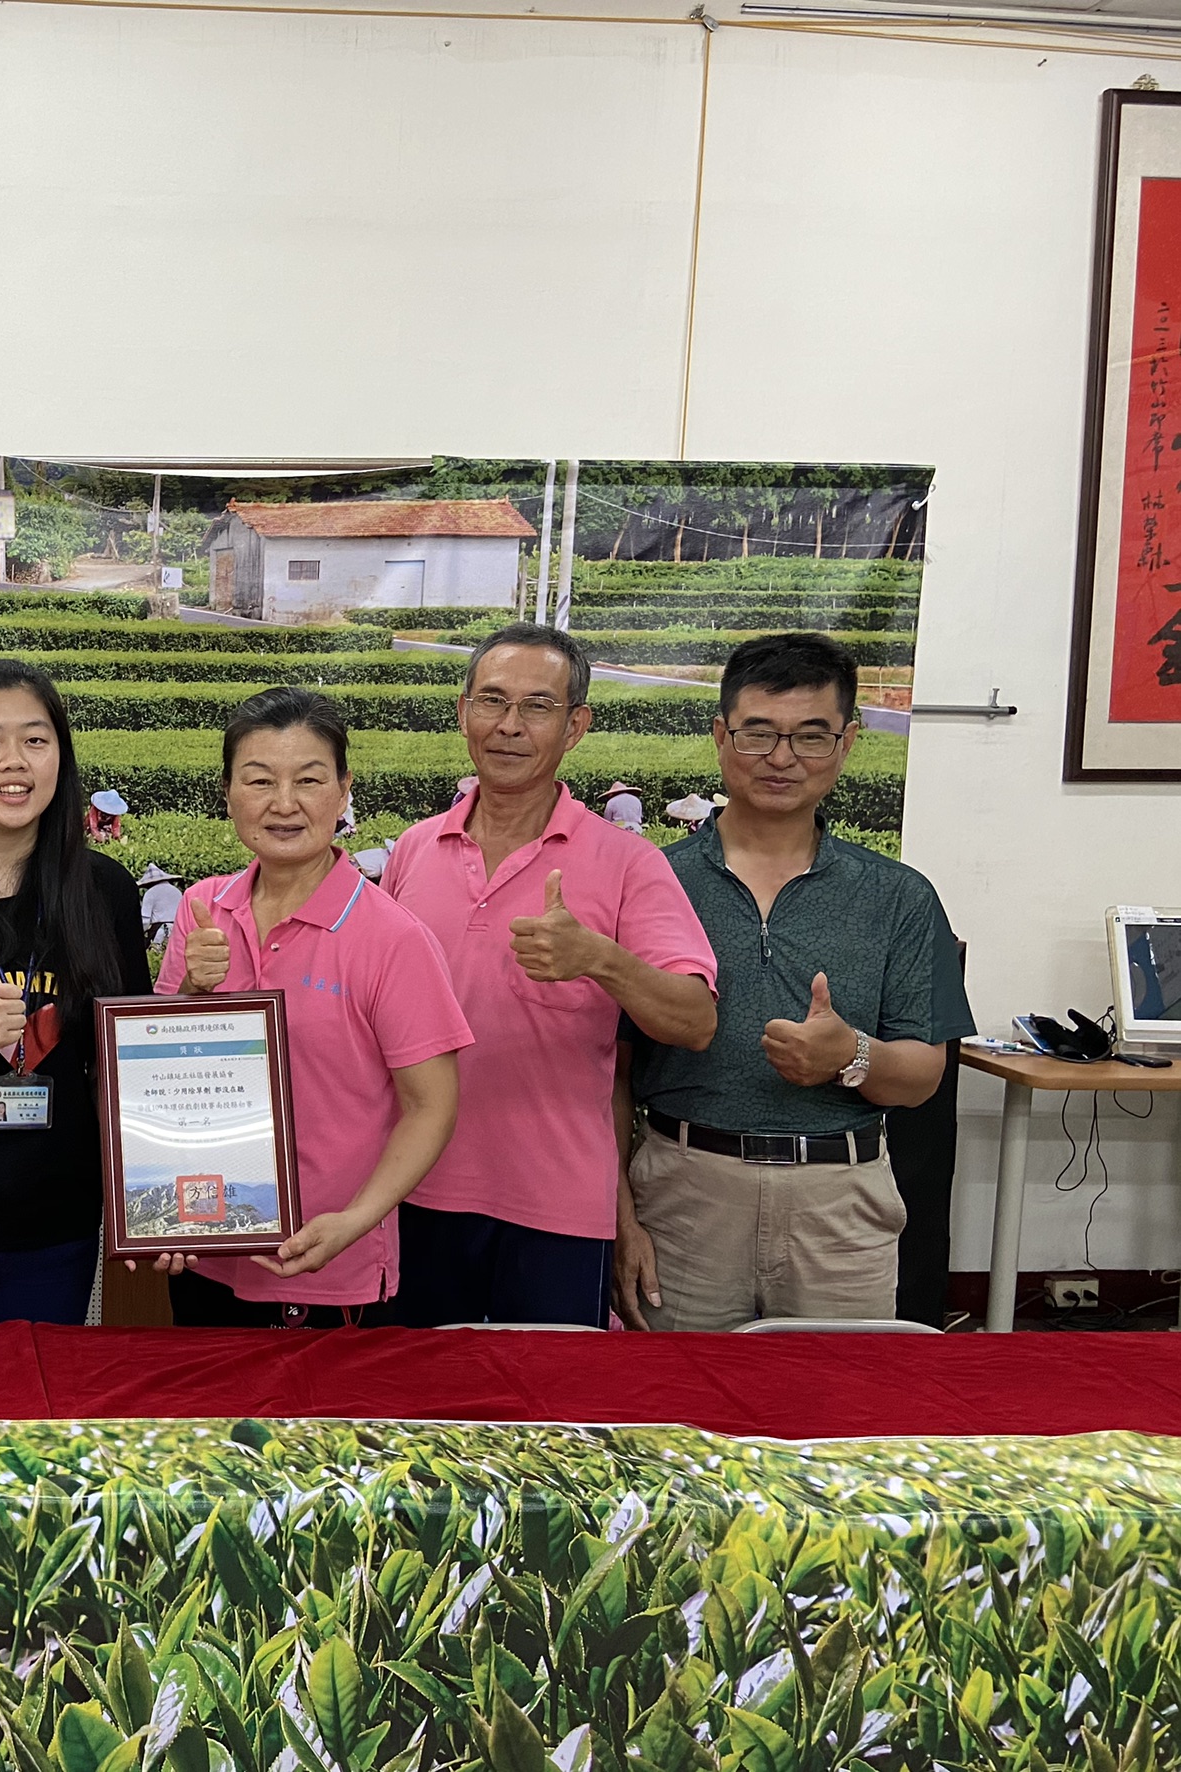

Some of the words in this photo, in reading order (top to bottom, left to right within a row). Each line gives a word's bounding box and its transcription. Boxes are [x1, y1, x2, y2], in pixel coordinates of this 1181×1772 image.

[161, 1023, 235, 1035] 南投縣政府環境保護局
[152, 1069, 234, 1081] 竹山鎮延正社區發展協會
